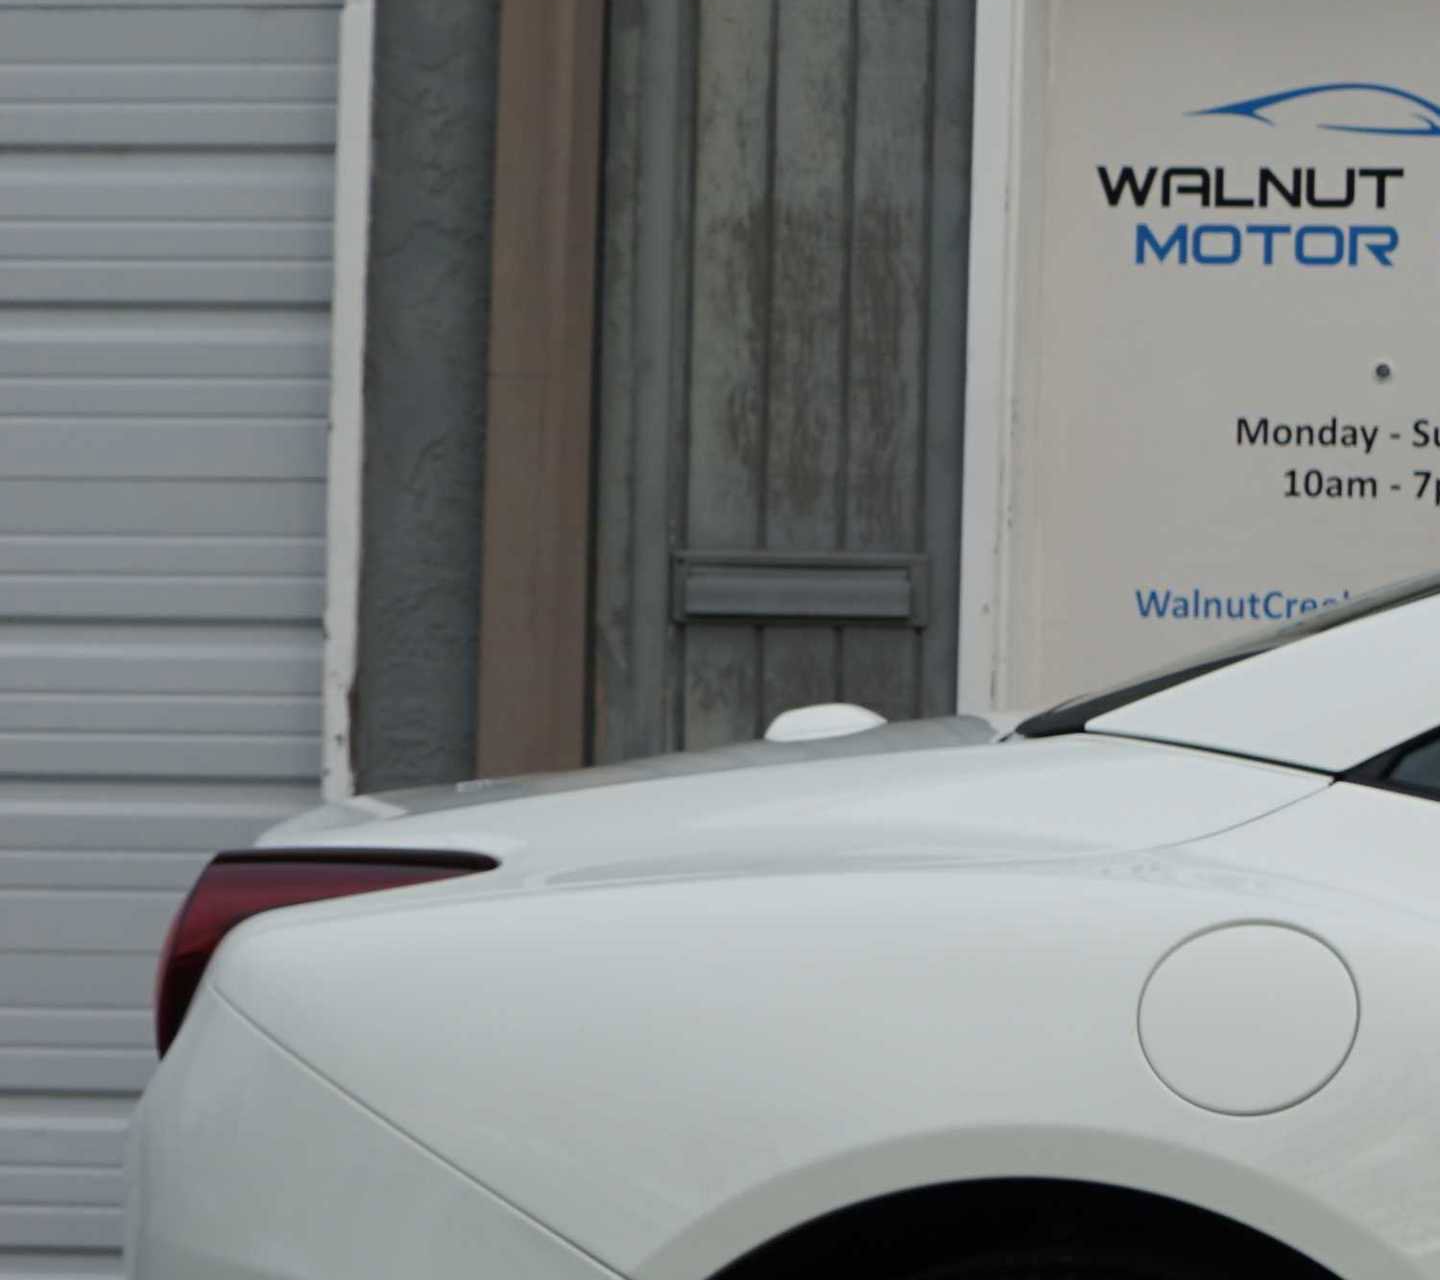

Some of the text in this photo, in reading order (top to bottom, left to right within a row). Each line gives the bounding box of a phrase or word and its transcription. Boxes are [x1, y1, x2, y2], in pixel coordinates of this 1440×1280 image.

[1096, 165, 1405, 209] WALNUT
[1135, 223, 1399, 267] MOTOR
[1236, 417, 1379, 455] Monday
[1284, 469, 1378, 499] 10am
[1135, 588, 1350, 620] WalnutCre
